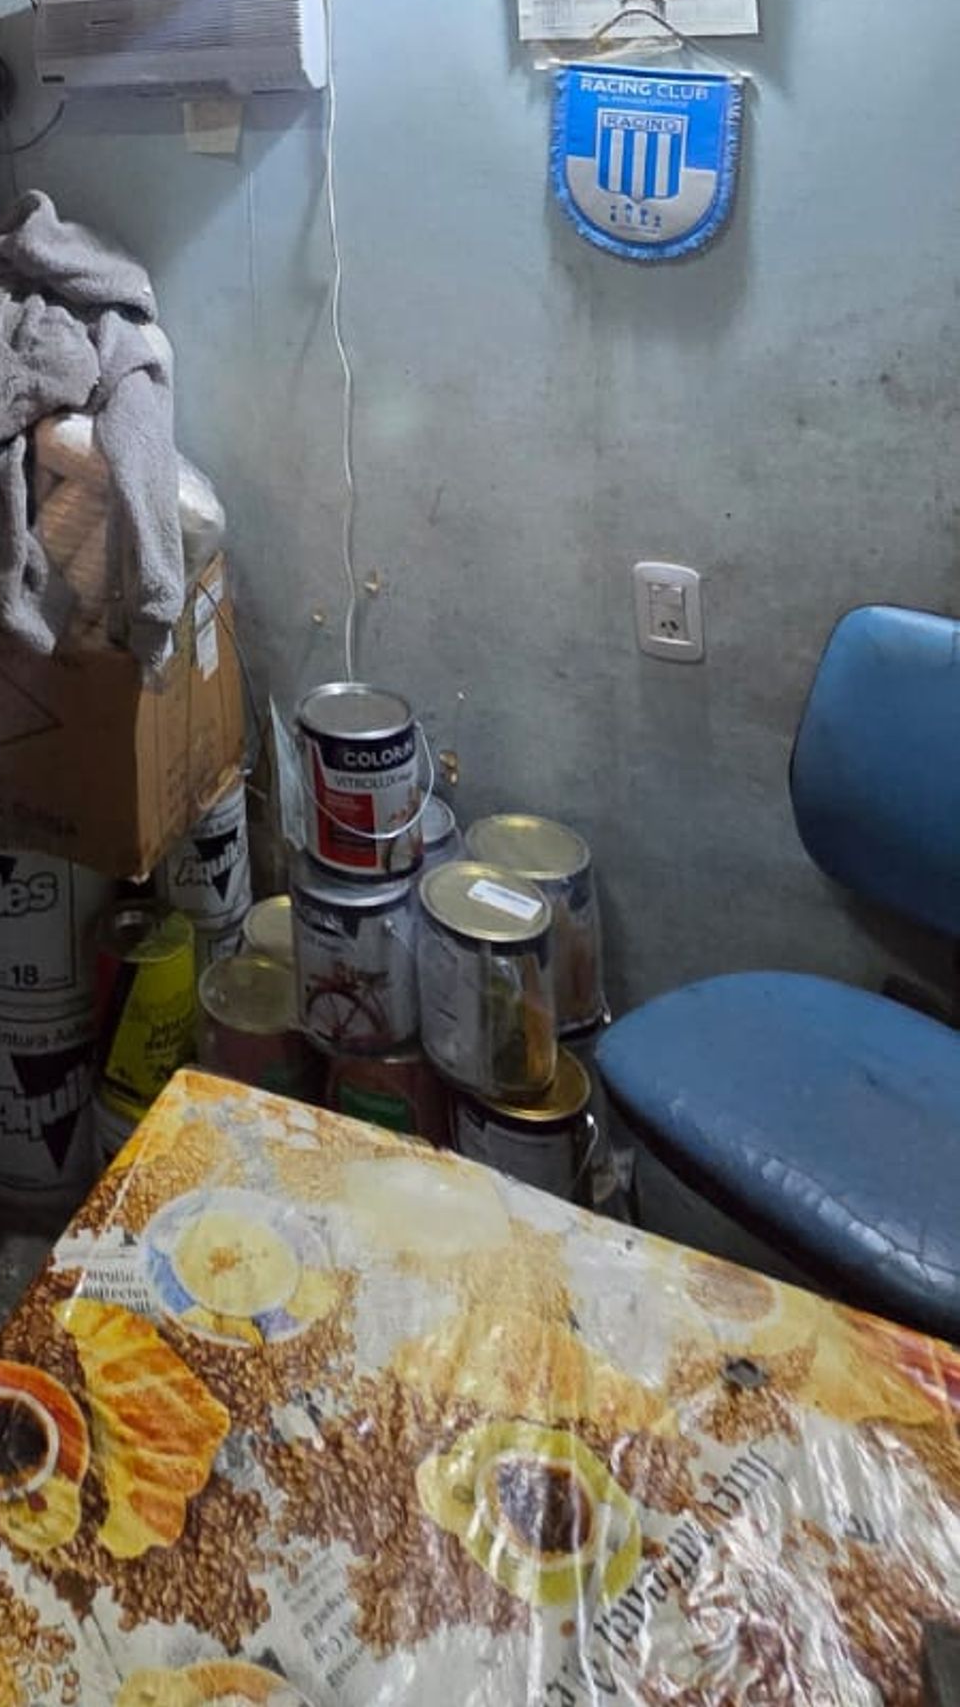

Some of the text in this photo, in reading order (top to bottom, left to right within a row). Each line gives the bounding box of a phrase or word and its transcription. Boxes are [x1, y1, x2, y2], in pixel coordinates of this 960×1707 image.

[580, 78, 709, 101] RACING CLUB
[9, 964, 40, 986] 18
